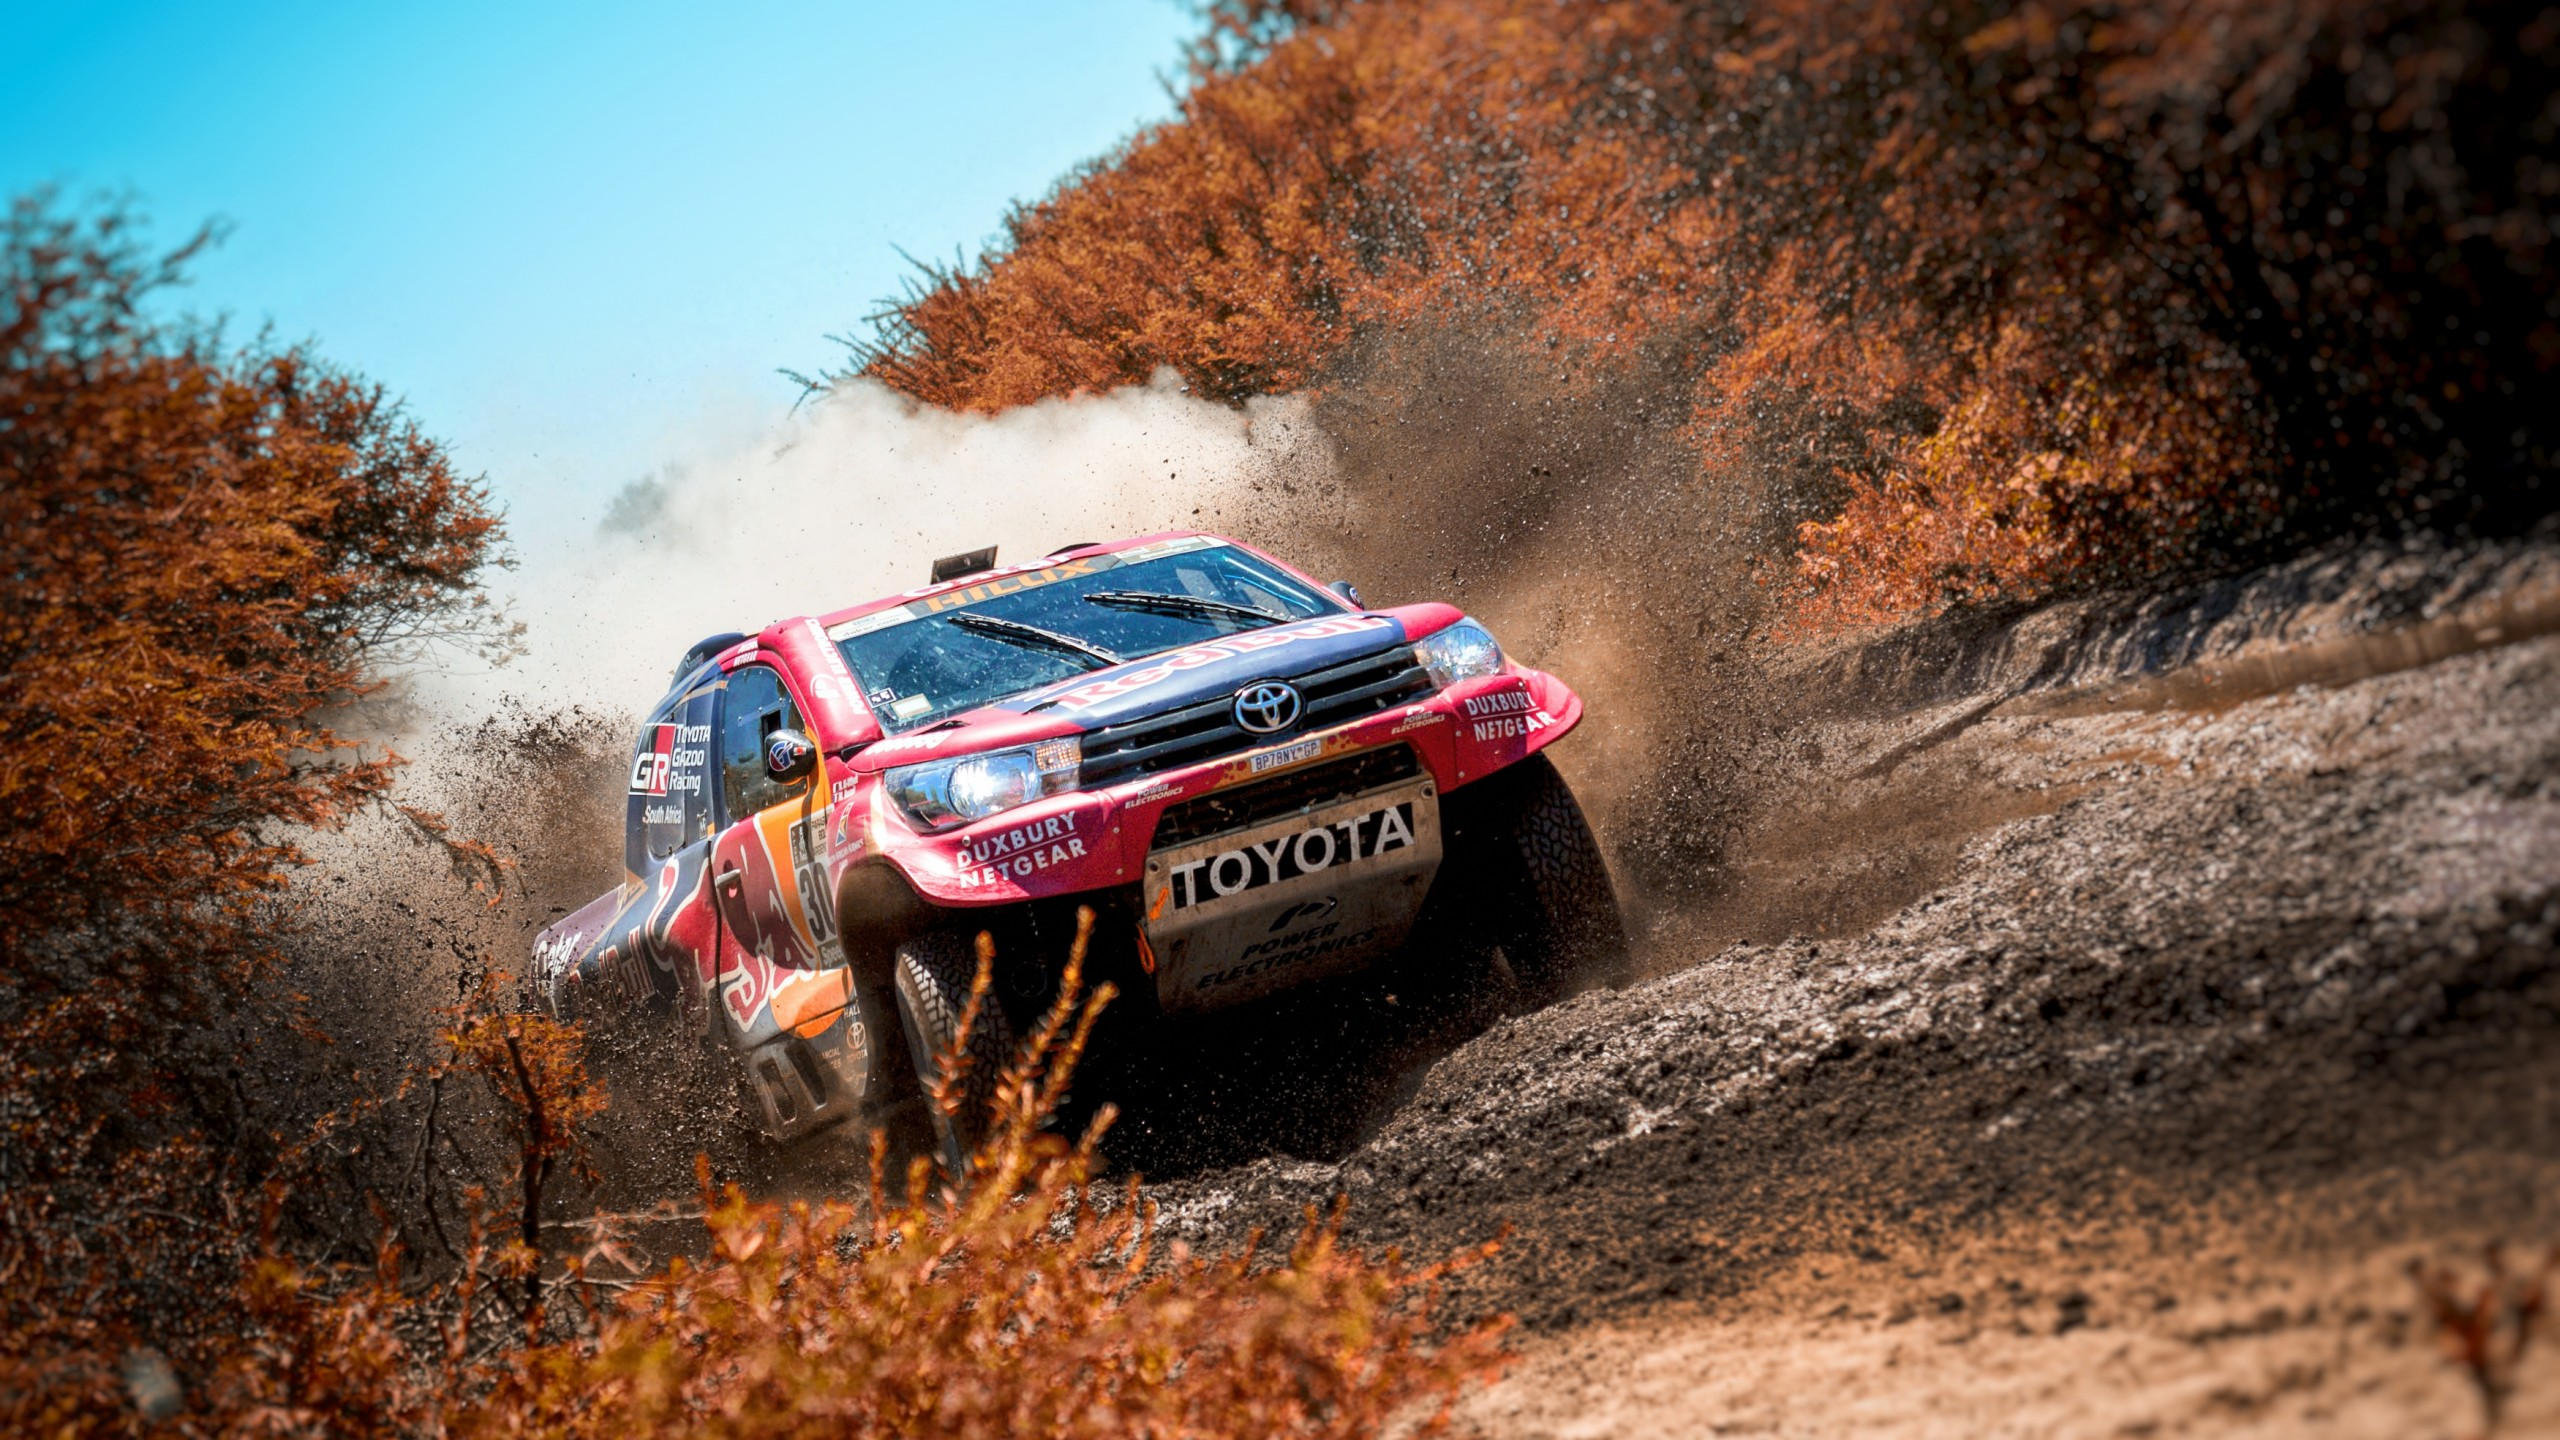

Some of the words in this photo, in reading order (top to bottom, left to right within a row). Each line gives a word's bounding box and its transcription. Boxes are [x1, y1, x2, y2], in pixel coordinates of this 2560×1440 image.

[1041, 645, 1235, 712] Red
[1230, 617, 1393, 655] Bull
[1464, 691, 1537, 716] DUXBURY
[676, 724, 712, 743] TOYOTA
[1473, 711, 1557, 742] NETGEAR
[631, 752, 670, 791] GR
[669, 770, 701, 797] Racing
[642, 804, 664, 824] South
[664, 805, 682, 824] Africa
[956, 810, 1076, 869] DUXBURY
[1171, 806, 1415, 906] TOYOTA
[959, 838, 1087, 889] NETGEAR
[1196, 928, 1377, 988] ELECTRONICS
[1241, 922, 1339, 960] POWER
